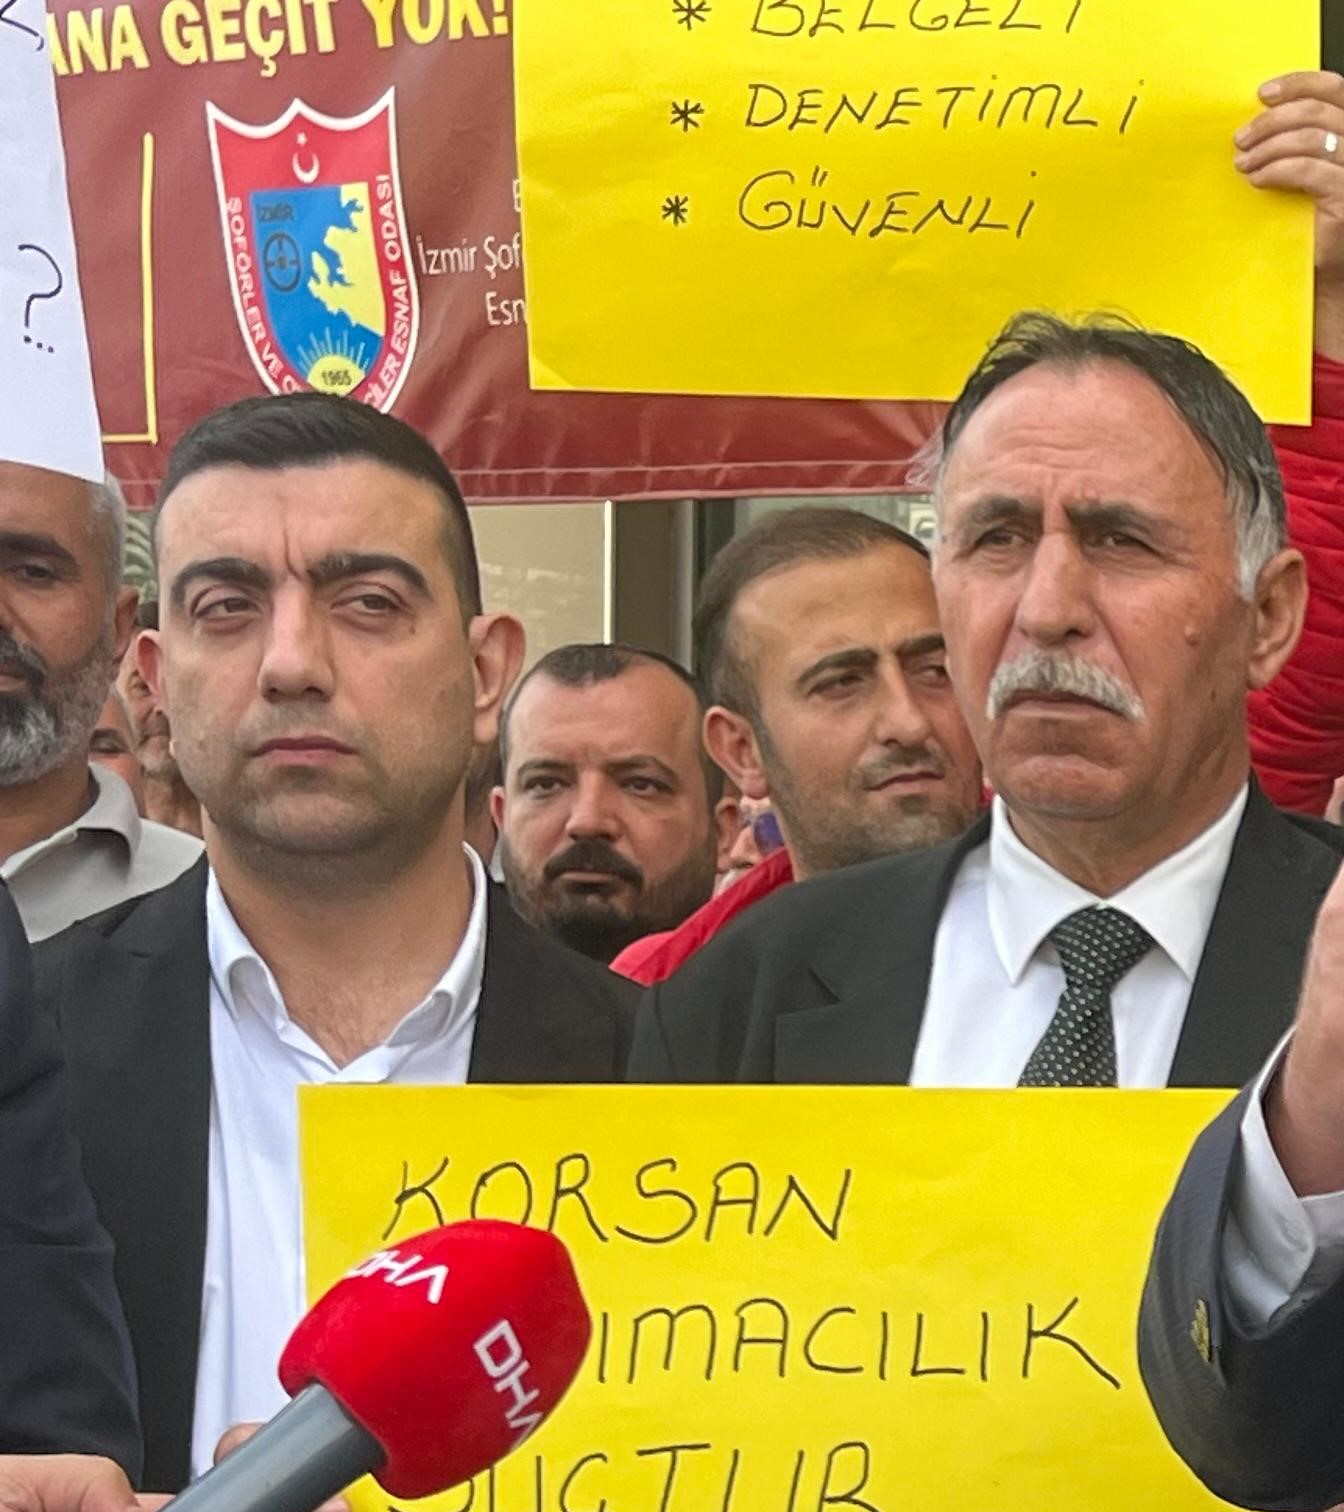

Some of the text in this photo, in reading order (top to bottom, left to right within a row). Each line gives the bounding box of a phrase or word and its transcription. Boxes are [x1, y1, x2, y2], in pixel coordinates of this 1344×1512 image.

[375, 173, 402, 263] ODASI
[738, 165, 1038, 239] GÜVENLİ
[415, 235, 478, 276] İzmir
[389, 269, 410, 355] ESNAF
[381, 1152, 852, 1244] KORSAN
[598, 1296, 1122, 1390] IMACILIK
